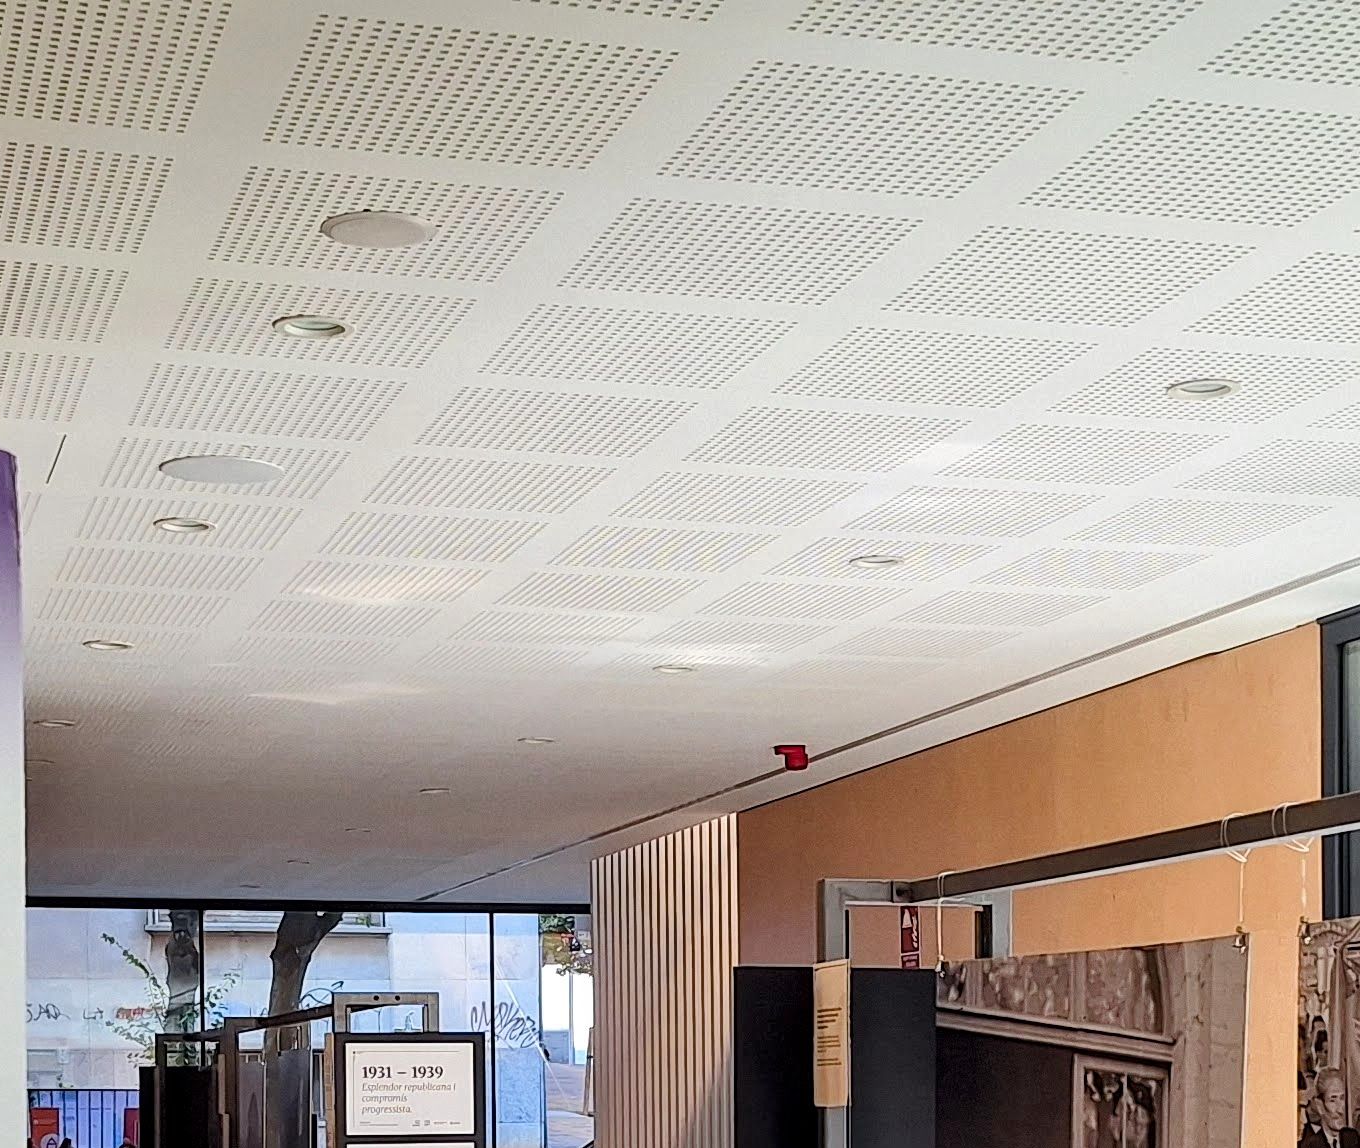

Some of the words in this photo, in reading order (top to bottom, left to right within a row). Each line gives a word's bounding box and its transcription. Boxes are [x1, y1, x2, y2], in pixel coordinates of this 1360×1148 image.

[362, 1066, 392, 1079] 1931
[412, 1066, 444, 1079] 1939
[362, 1083, 402, 1092] Esplendor
[404, 1083, 450, 1092] republicana
[362, 1094, 407, 1103] compromís
[362, 1105, 411, 1115] progressista.
